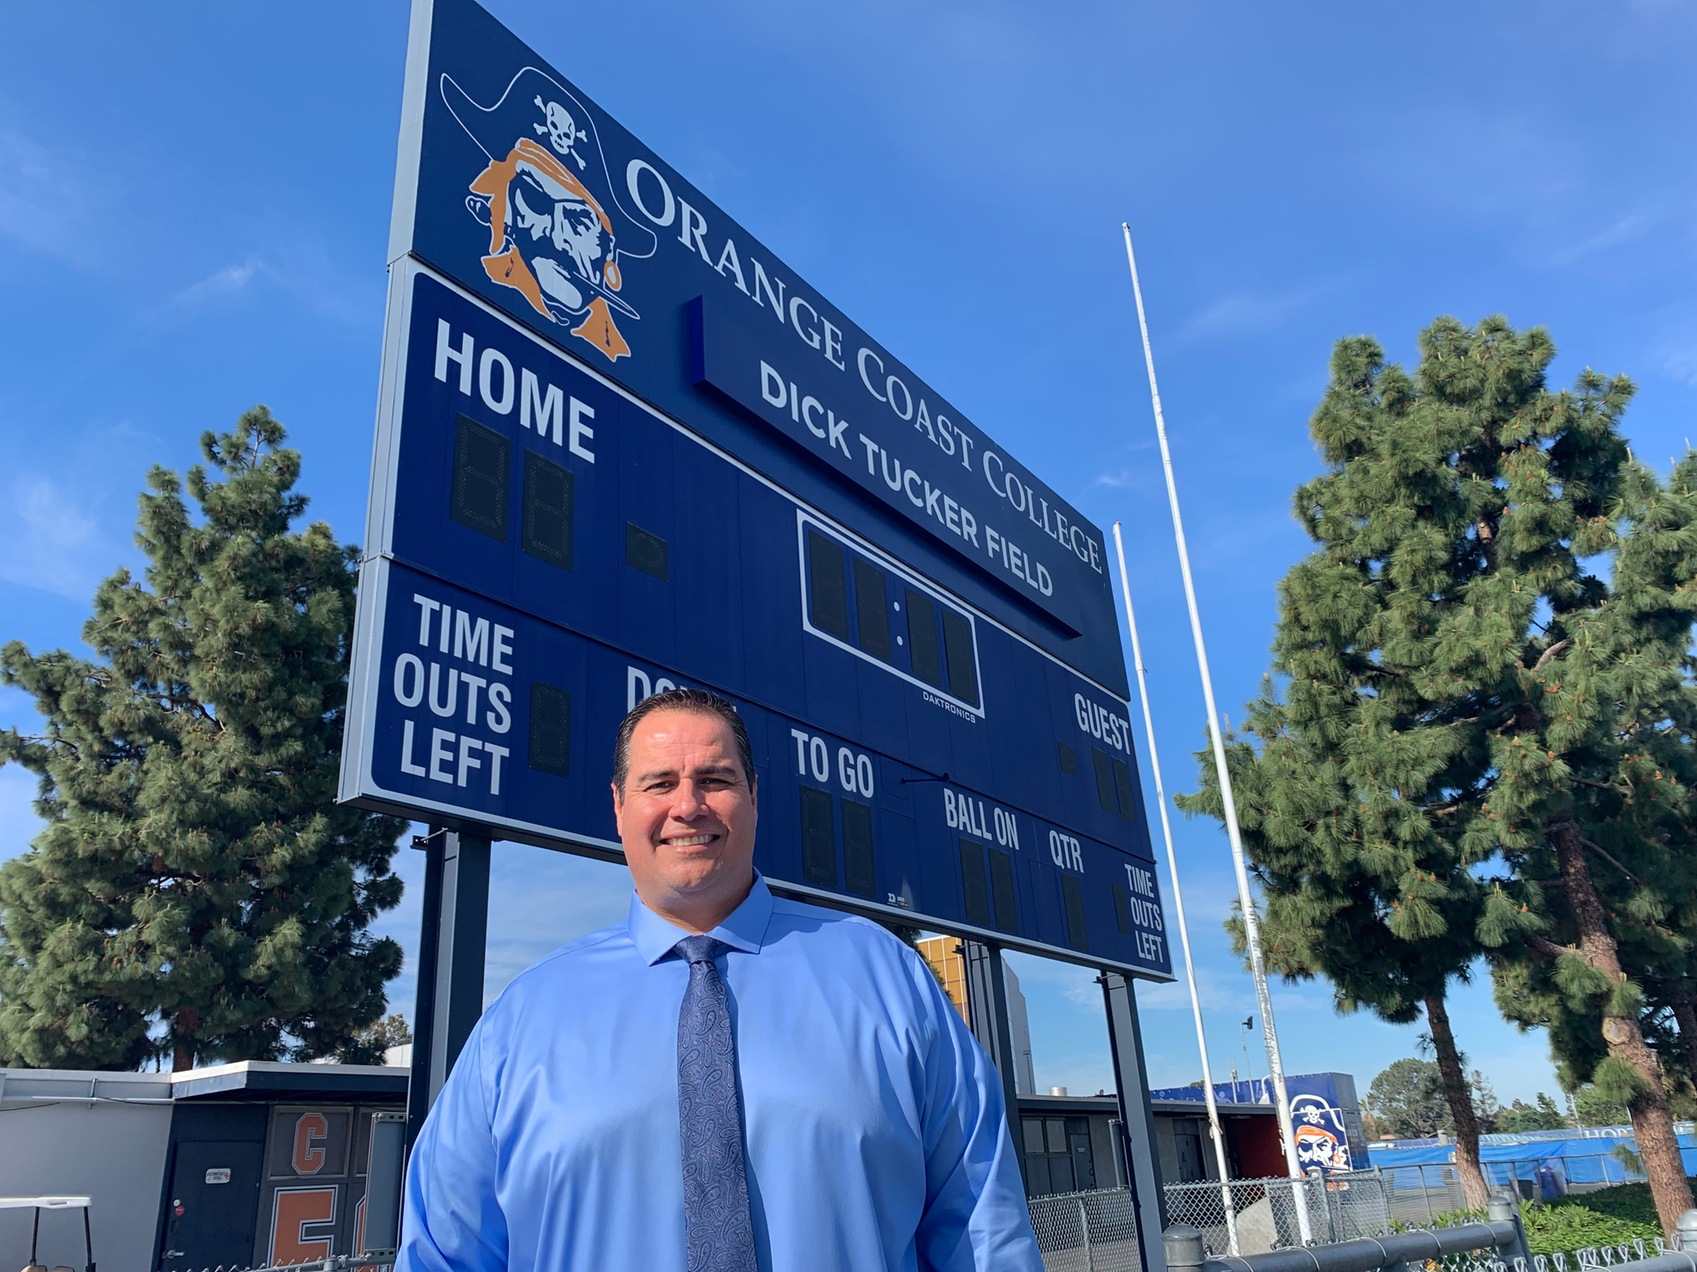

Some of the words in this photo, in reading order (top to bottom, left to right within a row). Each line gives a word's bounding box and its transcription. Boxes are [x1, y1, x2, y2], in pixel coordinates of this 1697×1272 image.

[434, 317, 595, 464] HOME
[627, 159, 846, 371] ORANGE
[858, 348, 973, 472] COAST
[983, 451, 1102, 574] COLLEGE
[760, 360, 852, 459] DICK
[860, 434, 979, 548] TUCKER
[986, 525, 1053, 596] FIELD
[413, 593, 514, 675] TIME
[394, 653, 512, 734] OUTS
[922, 692, 976, 723] DAKTRONICS
[1074, 693, 1131, 755] GUEST
[401, 720, 509, 795] LEFT
[791, 728, 829, 783] TO
[838, 747, 874, 798] GO
[943, 788, 992, 840] BALL
[994, 808, 1019, 850] ON
[1049, 830, 1084, 873] QTR
[1124, 864, 1154, 898] TIME
[1131, 897, 1162, 931] OUTS
[1136, 931, 1163, 963] LEFT
